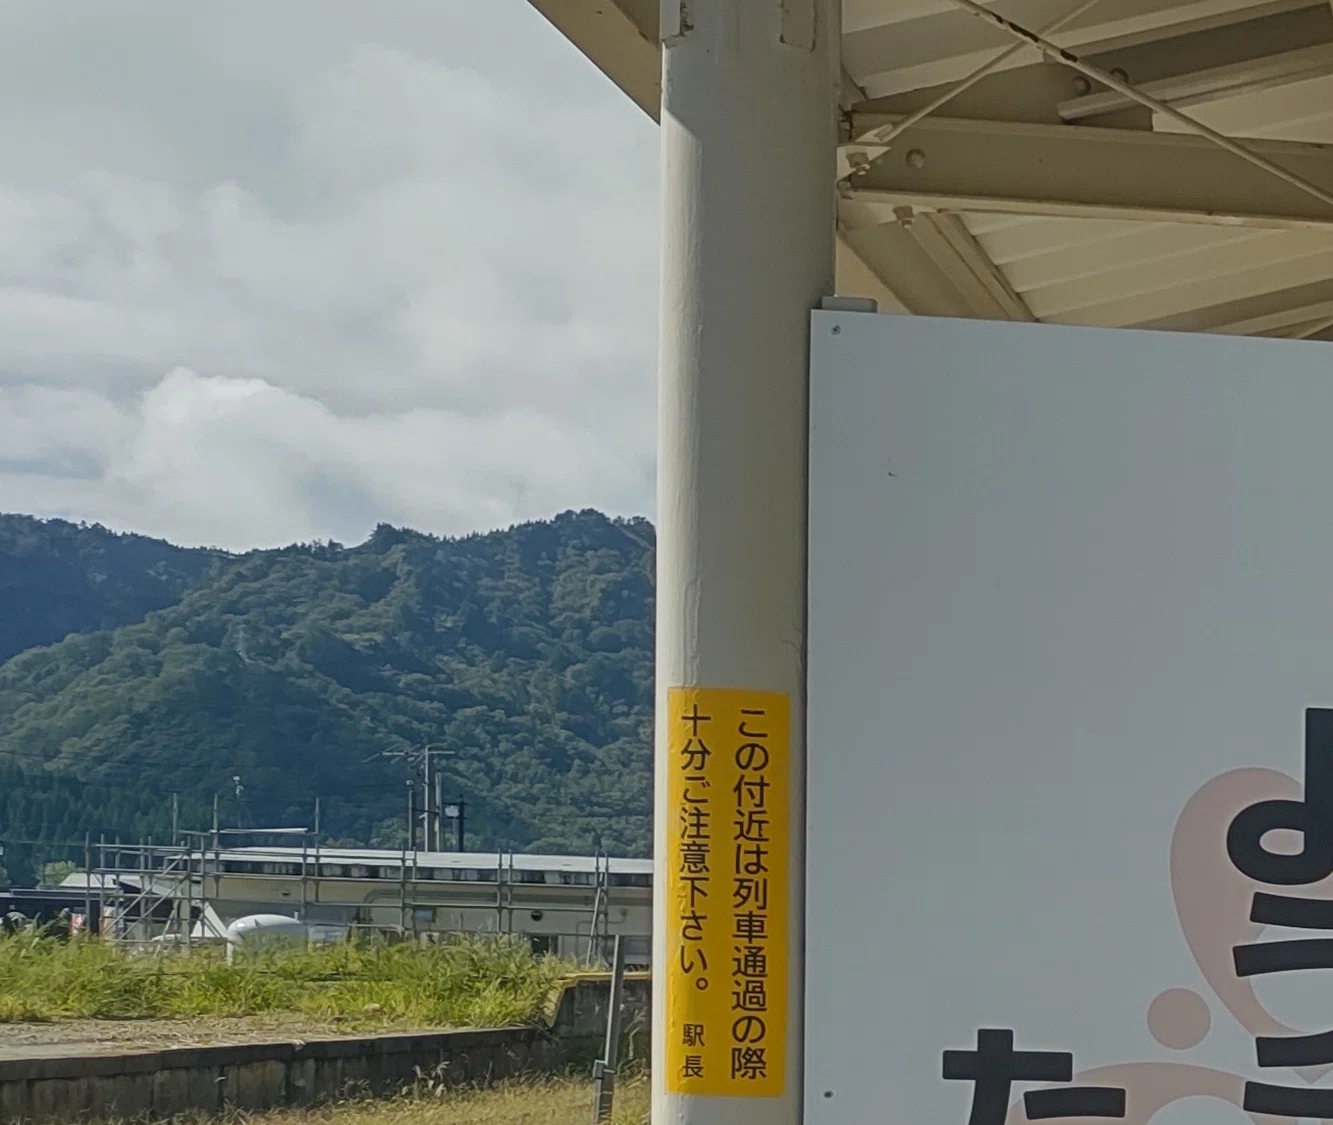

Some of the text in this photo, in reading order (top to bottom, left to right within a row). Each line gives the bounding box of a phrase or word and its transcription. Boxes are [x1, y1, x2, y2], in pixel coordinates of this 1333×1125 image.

[680, 704, 712, 1079] 十分ご注意下さい。 駅長
[731, 708, 770, 1081] この付近は列車通過の際
